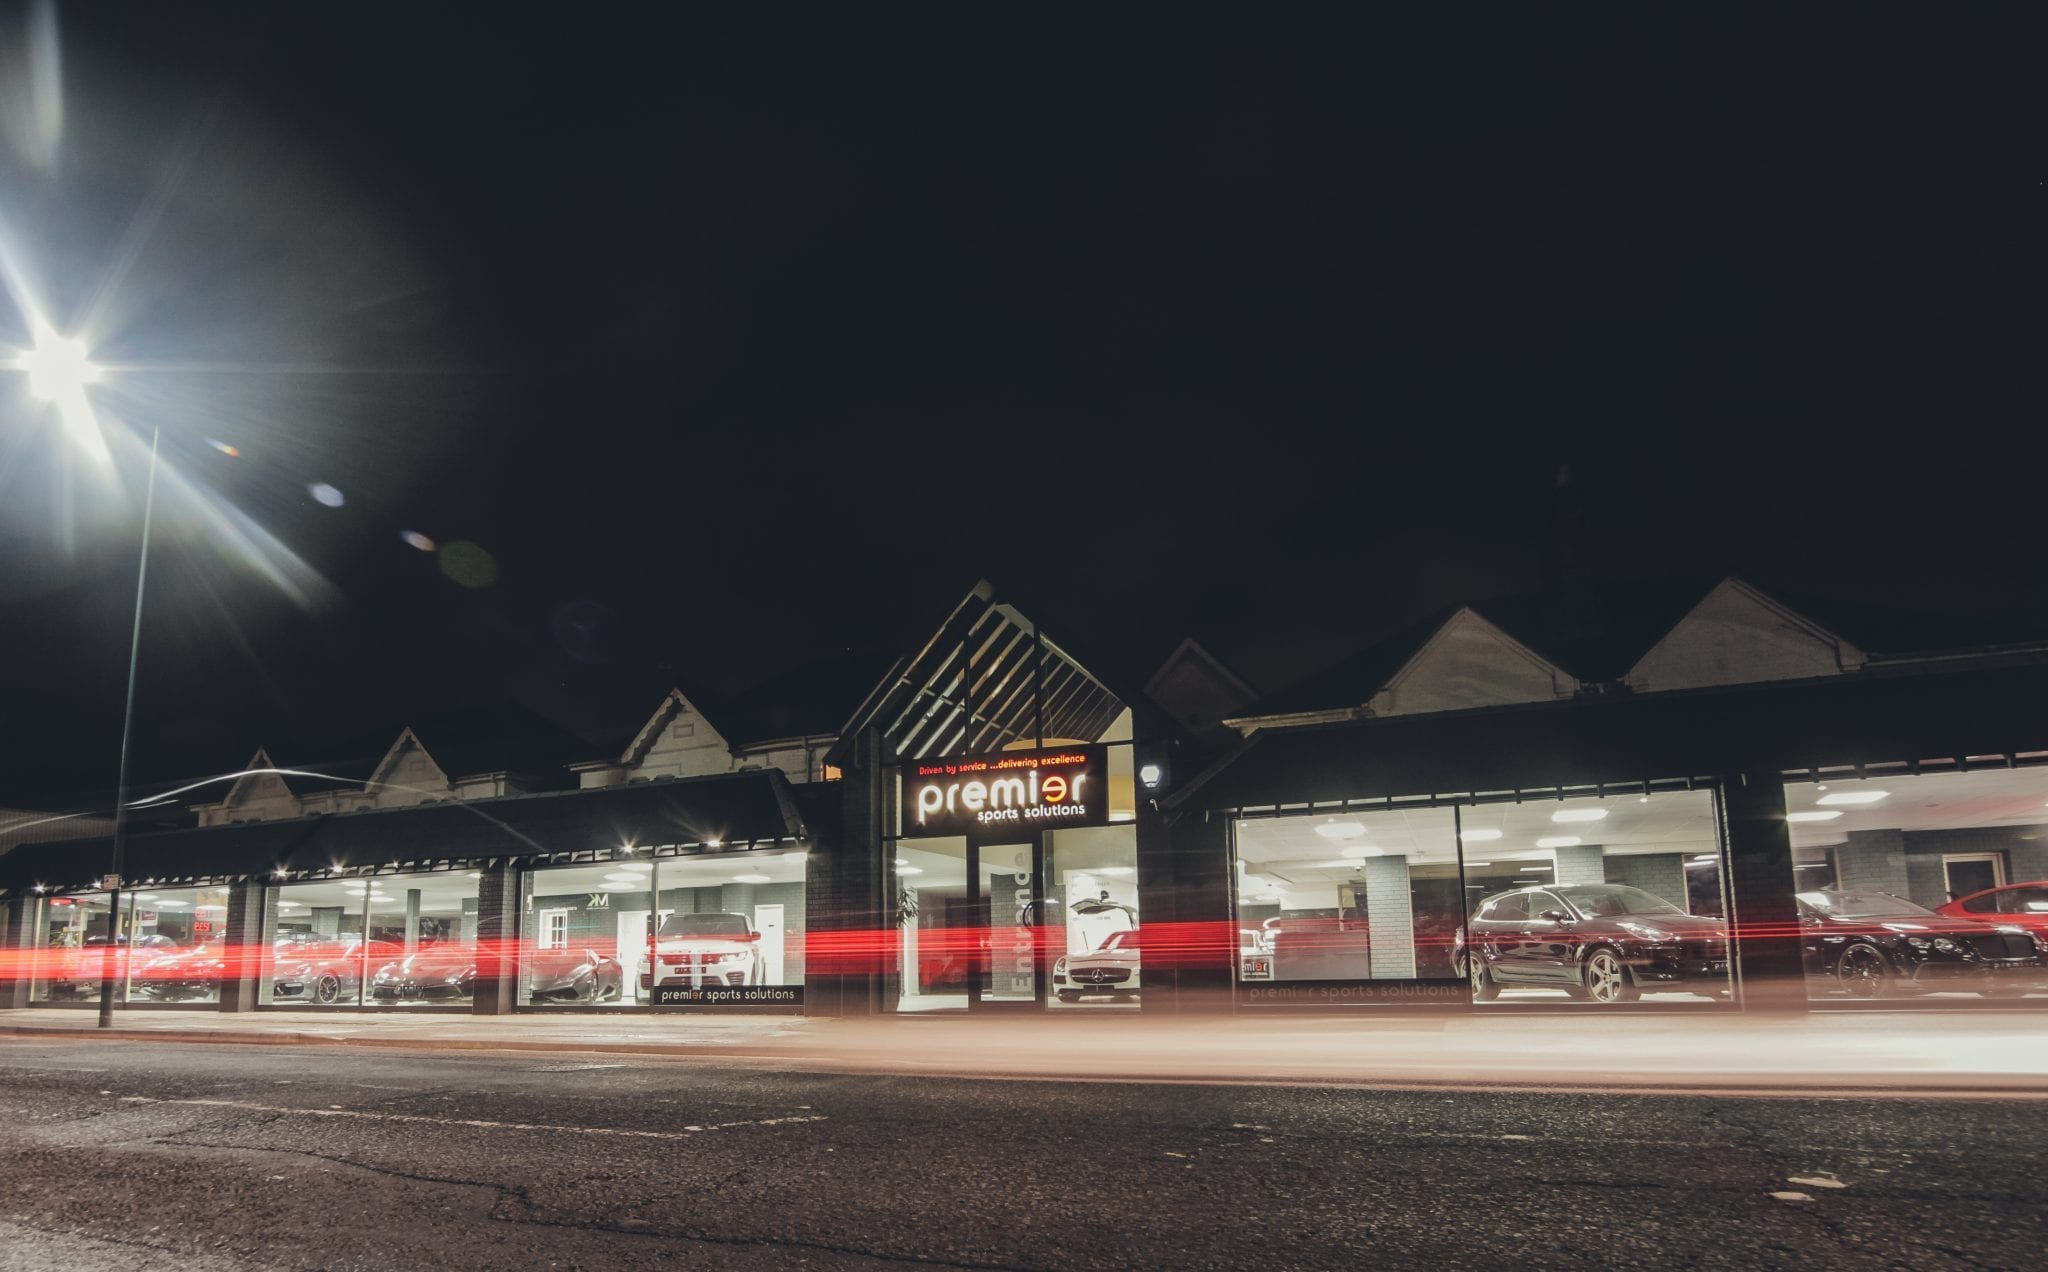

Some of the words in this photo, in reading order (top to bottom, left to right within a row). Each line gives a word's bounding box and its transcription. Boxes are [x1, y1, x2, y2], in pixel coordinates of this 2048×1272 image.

[919, 766, 943, 775] Driven
[946, 765, 957, 775] by
[959, 763, 987, 772] service
[1041, 754, 1086, 766] excellence
[918, 770, 1087, 826] premier
[977, 807, 1019, 824] sports
[1024, 804, 1086, 818] solutions
[1011, 852, 1033, 992] Entrance
[661, 989, 703, 1003] premier
[706, 989, 741, 1004] sports
[745, 987, 795, 1000] solutions
[1250, 985, 1313, 1001] premir
[1320, 984, 1374, 1001] sports
[1380, 983, 1459, 997] solutions
